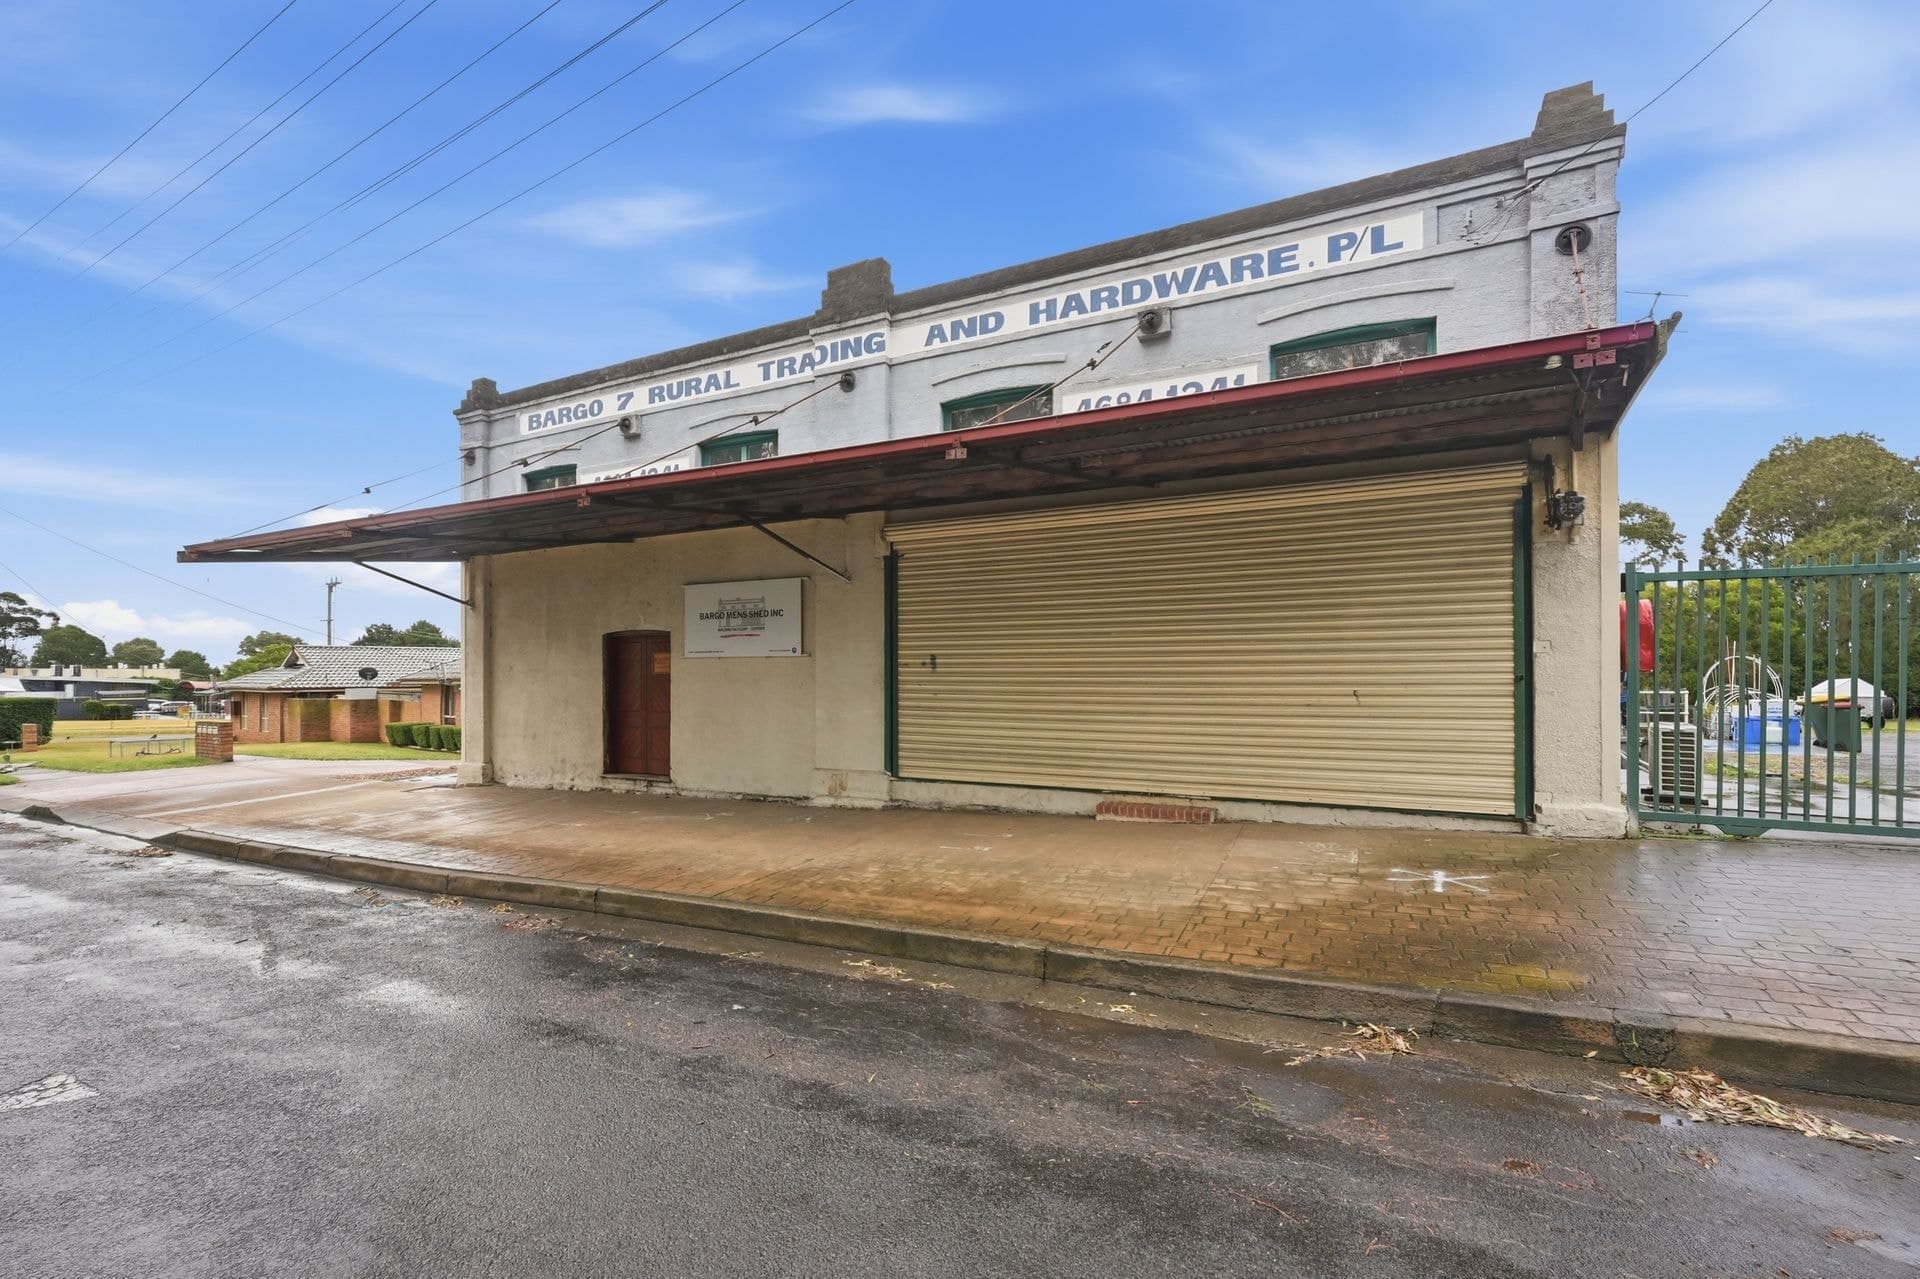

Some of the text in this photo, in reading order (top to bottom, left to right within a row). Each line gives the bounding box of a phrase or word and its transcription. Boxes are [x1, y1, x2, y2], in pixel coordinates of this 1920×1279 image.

[528, 400, 604, 431] BARGO
[616, 391, 634, 411] 7
[649, 371, 739, 404] RURAL
[757, 332, 886, 381] TRADING
[925, 312, 1004, 346] AND
[1328, 225, 1403, 264] P/L
[699, 609, 784, 620] BARGO MENS SHED INC
